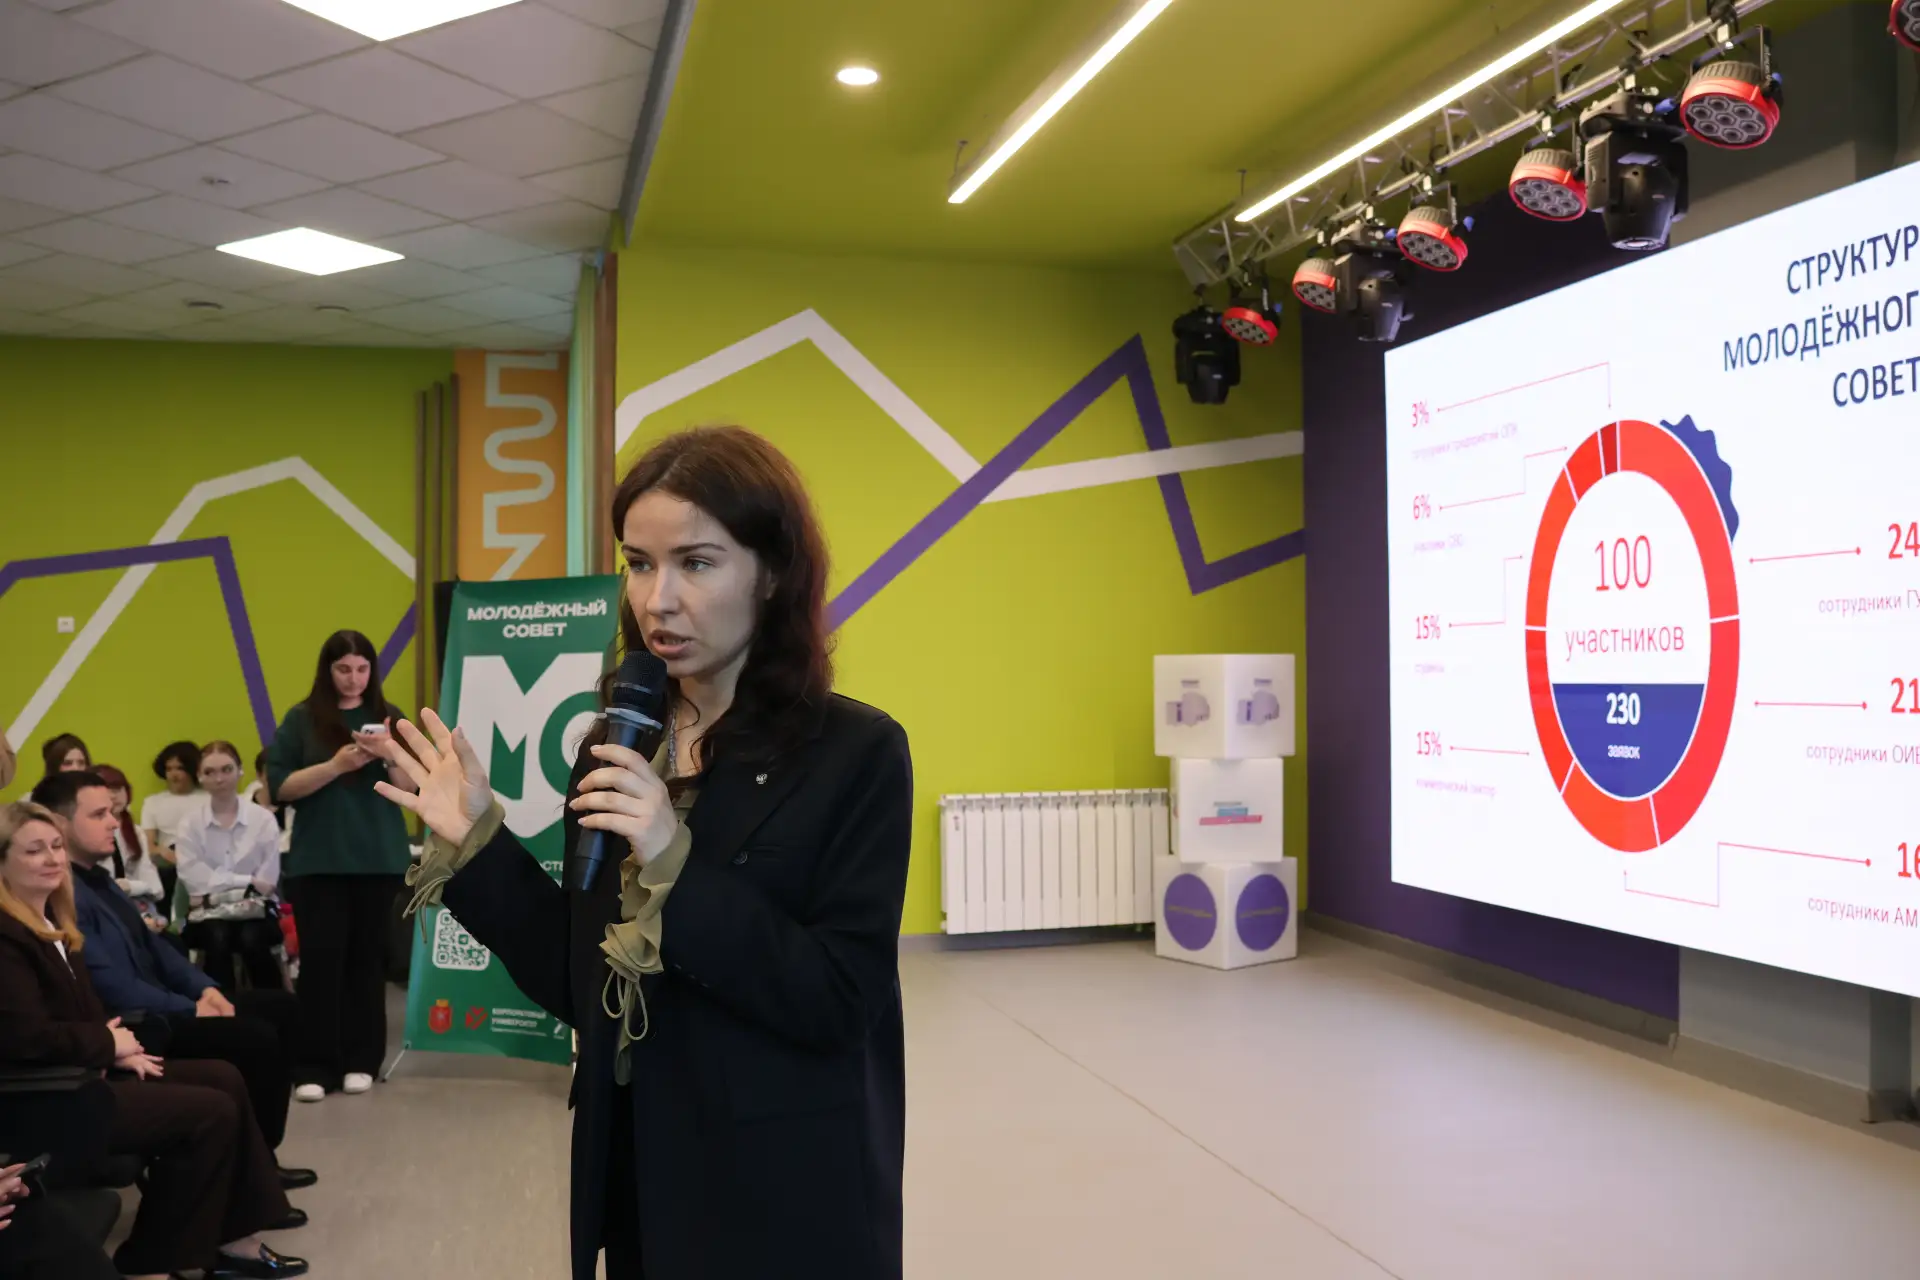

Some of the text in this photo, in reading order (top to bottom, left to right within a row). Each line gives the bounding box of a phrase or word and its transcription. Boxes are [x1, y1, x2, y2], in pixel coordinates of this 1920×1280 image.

[1787, 224, 1920, 294] СТРУКТУР
[1723, 290, 1920, 372] МОЛОДЁЖНОГ
[1833, 356, 1920, 407] СОВЕТ
[1412, 400, 1430, 428] 3%
[1413, 494, 1431, 520] 6%
[1888, 521, 1920, 560] 24
[1594, 535, 1652, 592] 100
[467, 598, 608, 621] МОЛОДЁЖНЫЙ
[1818, 595, 1902, 618] сотрудники
[502, 622, 568, 639] СОВЕТ
[1415, 615, 1441, 640] 15%
[1565, 626, 1685, 662] участников
[1606, 692, 1641, 725] 230
[1890, 677, 1920, 714] 21
[1416, 731, 1442, 756] 15%
[1607, 745, 1640, 759] заявок
[1806, 744, 1888, 766] сотрудники
[1807, 896, 1889, 924] сотрудники
